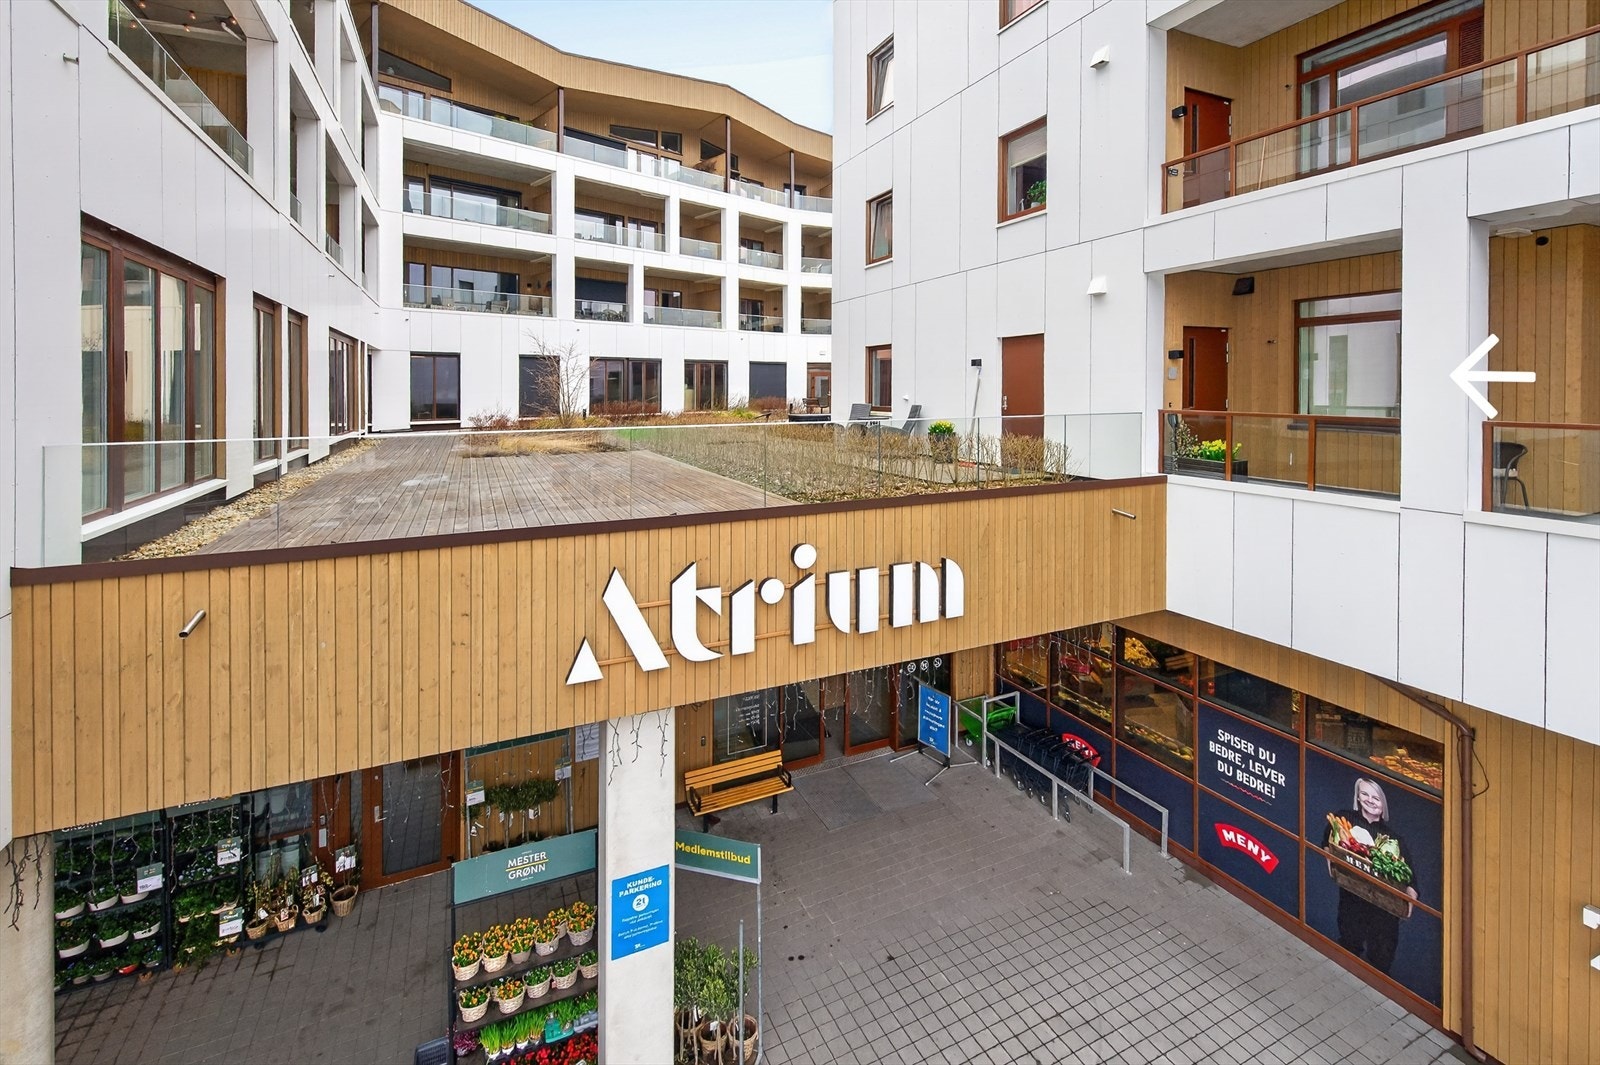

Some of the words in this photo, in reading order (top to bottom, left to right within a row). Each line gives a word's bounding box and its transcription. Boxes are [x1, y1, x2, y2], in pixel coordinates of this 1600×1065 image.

[566, 543, 964, 686] Atrium
[1217, 729, 1255, 754] SPISER
[1258, 747, 1276, 765] DU
[1209, 741, 1245, 769] BEDRE,
[1249, 760, 1286, 787] LEVER
[1217, 760, 1233, 777] DU
[1236, 770, 1276, 799] BEDRE!
[507, 851, 547, 868] MESTER
[675, 842, 751, 865] Medlemstilbud
[1222, 829, 1272, 863] MENY
[508, 863, 546, 880] GRØNN
[627, 876, 655, 889] KUNDE-
[619, 880, 662, 897] PARKERING
